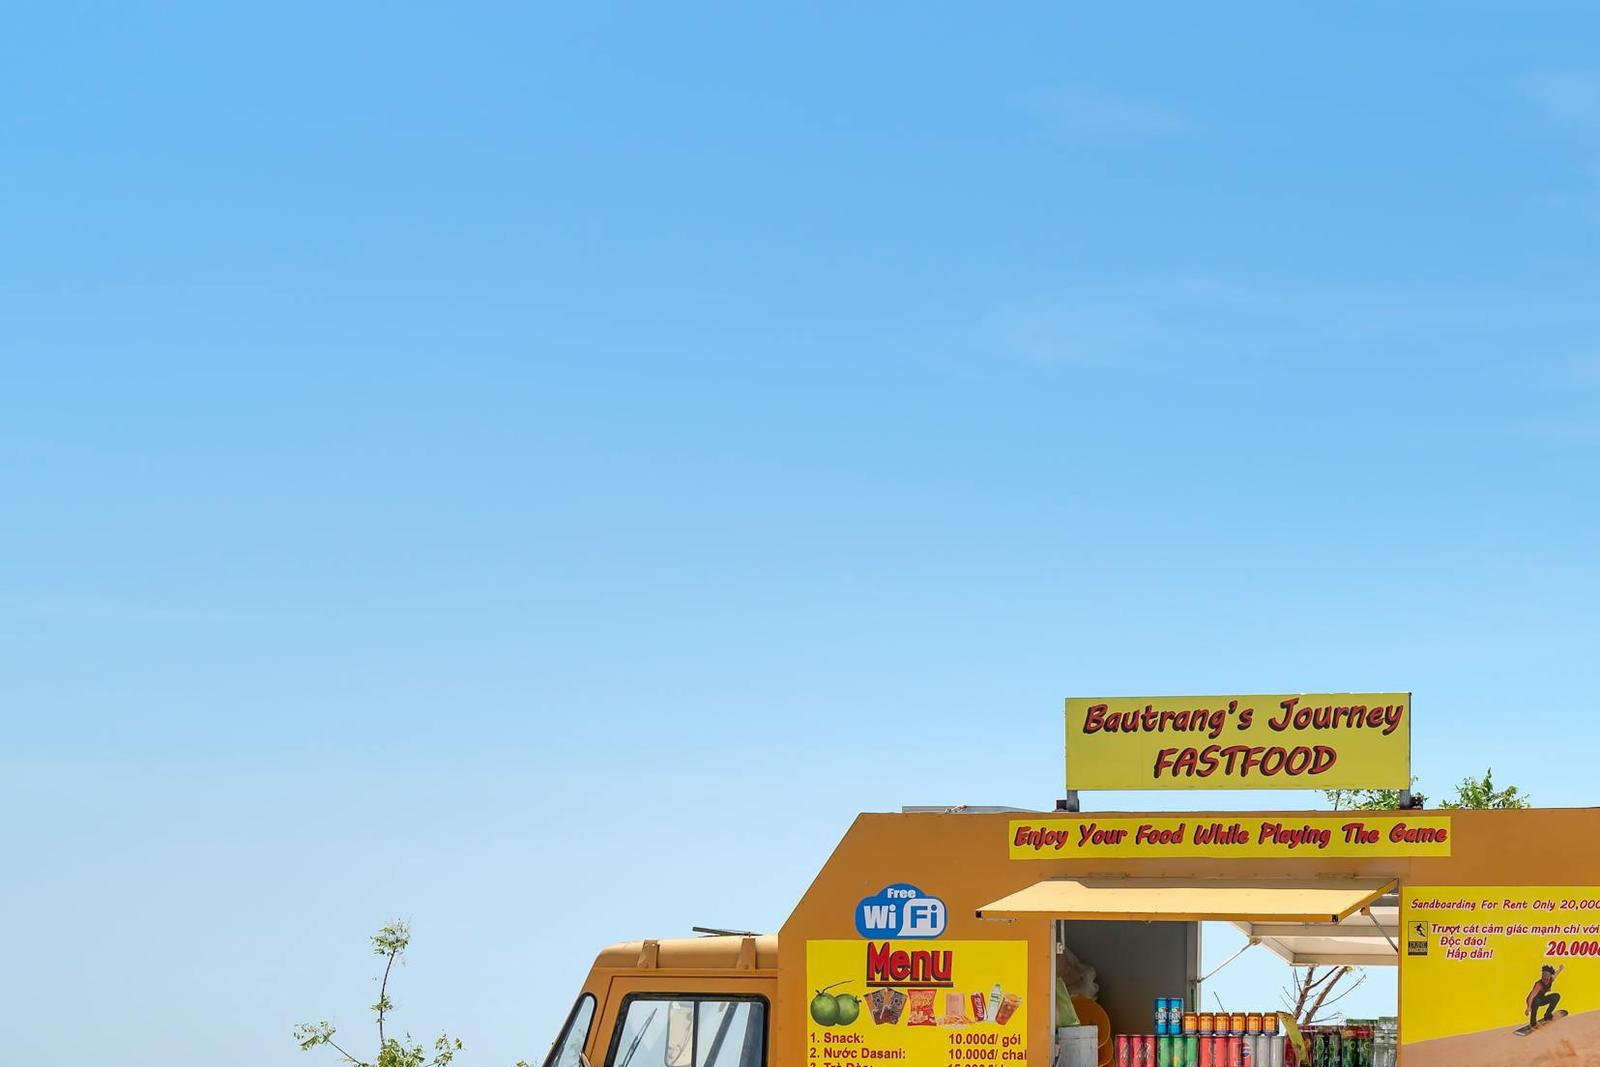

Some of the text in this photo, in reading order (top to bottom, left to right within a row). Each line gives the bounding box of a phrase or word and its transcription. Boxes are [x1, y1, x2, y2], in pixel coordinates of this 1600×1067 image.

[1083, 697, 1404, 739] Bautrang's Journey
[1153, 745, 1337, 778] FASTFOOD
[1014, 822, 1447, 850] Enjoy Your Food While Playing The Game
[887, 888, 916, 899] Free
[1411, 899, 1476, 911] Sandboarding
[1481, 899, 1498, 909] For
[1503, 899, 1527, 909] Rent
[1532, 899, 1555, 911] Only
[1431, 924, 1460, 935] Trượt
[1463, 924, 1479, 933] cát
[1506, 924, 1528, 935] giác
[1531, 924, 1560, 935] mạnh
[1583, 924, 1600, 934] với
[1440, 936, 1461, 947] Độc
[866, 941, 953, 982] Menu
[810, 1032, 820, 1043] 1.
[823, 1032, 864, 1043] Snack:
[1002, 1033, 1021, 1048] gói
[810, 1047, 820, 1058] 2.
[823, 1047, 858, 1059] Nước
[861, 1047, 906, 1059] Dasani:
[1002, 1048, 1027, 1060] chai
